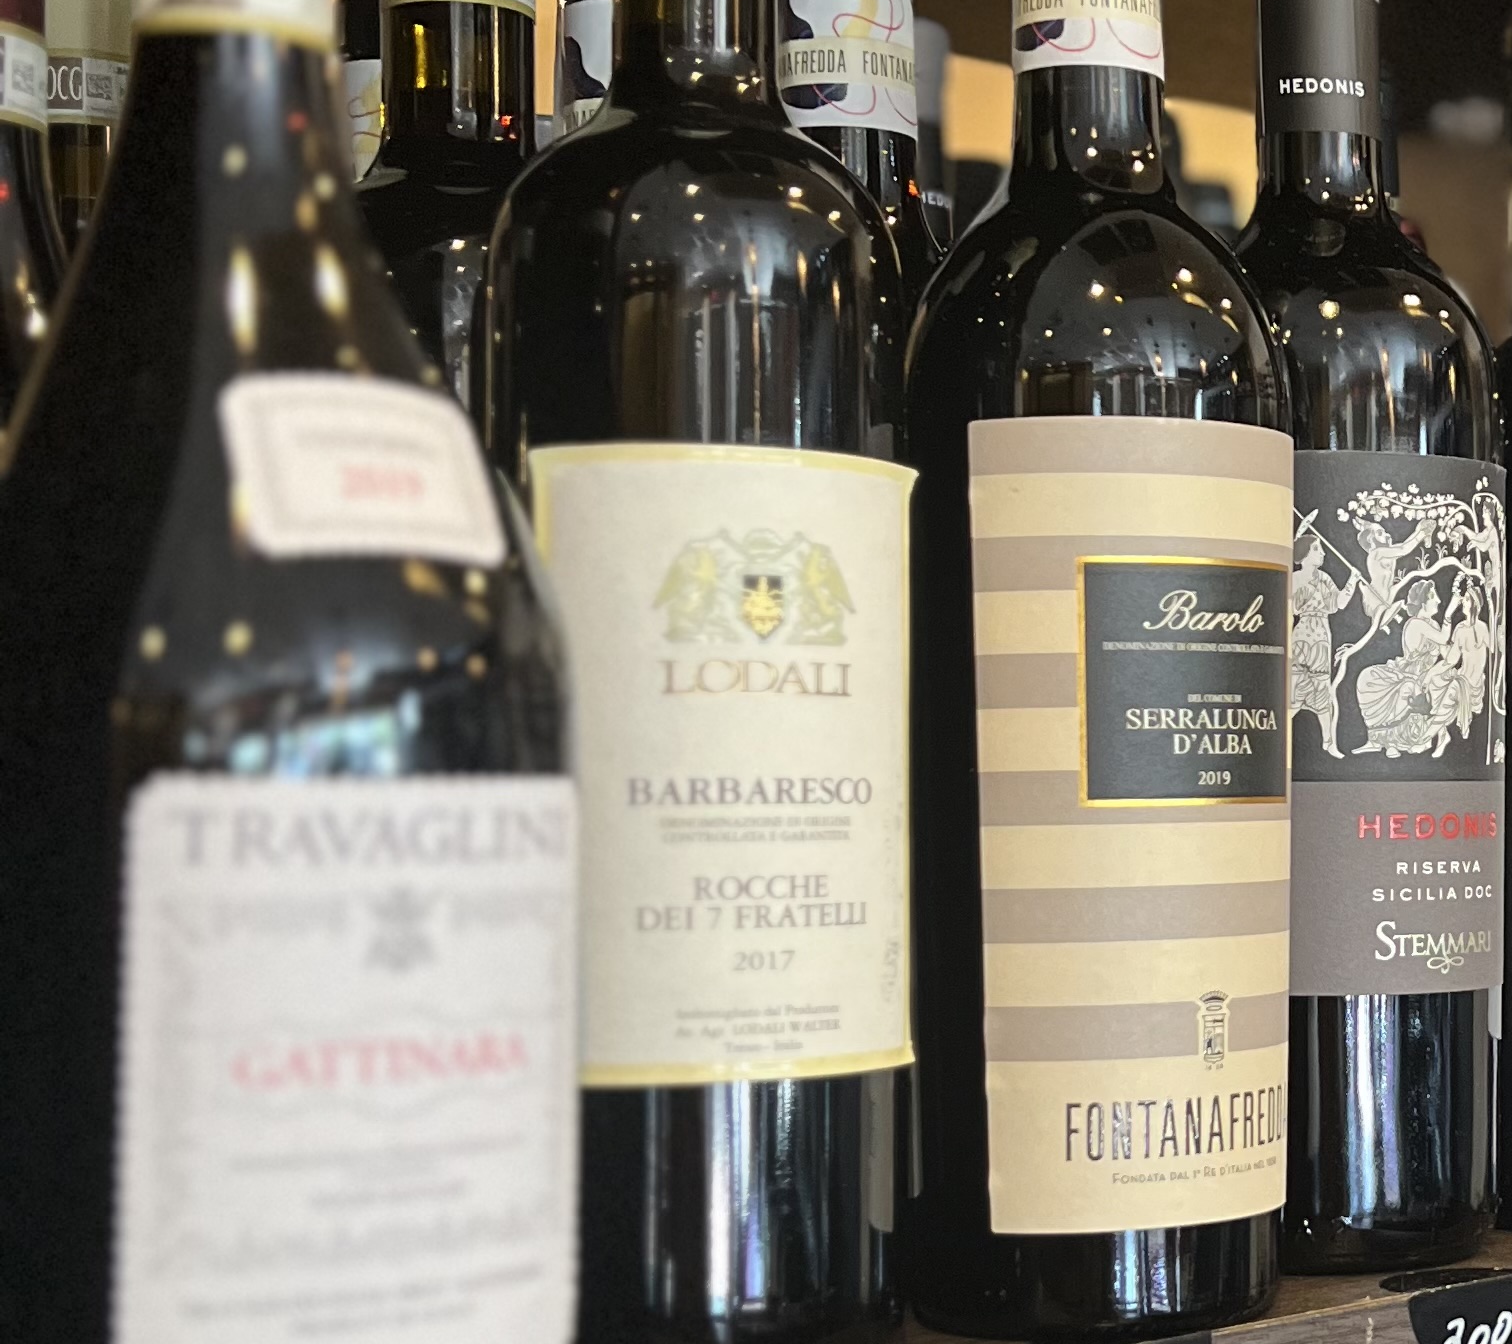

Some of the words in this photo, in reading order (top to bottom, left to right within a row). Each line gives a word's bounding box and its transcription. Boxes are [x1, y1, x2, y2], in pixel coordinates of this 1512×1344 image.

[1278, 77, 1366, 99] HEDONIS
[1142, 588, 1265, 634] Barolo
[659, 659, 853, 698] LODALI
[1124, 707, 1278, 731] SERRALUNGA
[1172, 733, 1253, 756] D'ALBA
[1197, 770, 1233, 786] 2019
[625, 775, 874, 807] BARBARESCO
[1357, 811, 1498, 840] HEDONIS
[1396, 859, 1482, 875] RISERVA
[693, 873, 830, 902] ROCCHE
[1372, 886, 1458, 903] SICILIA
[1464, 884, 1493, 900] DOC
[636, 906, 694, 932] DEI
[705, 907, 723, 930] 7
[734, 901, 868, 931] FRATELLI
[731, 950, 797, 972] 2017
[1112, 1171, 1166, 1185] FONDATA
[1169, 1170, 1189, 1182] DAL
